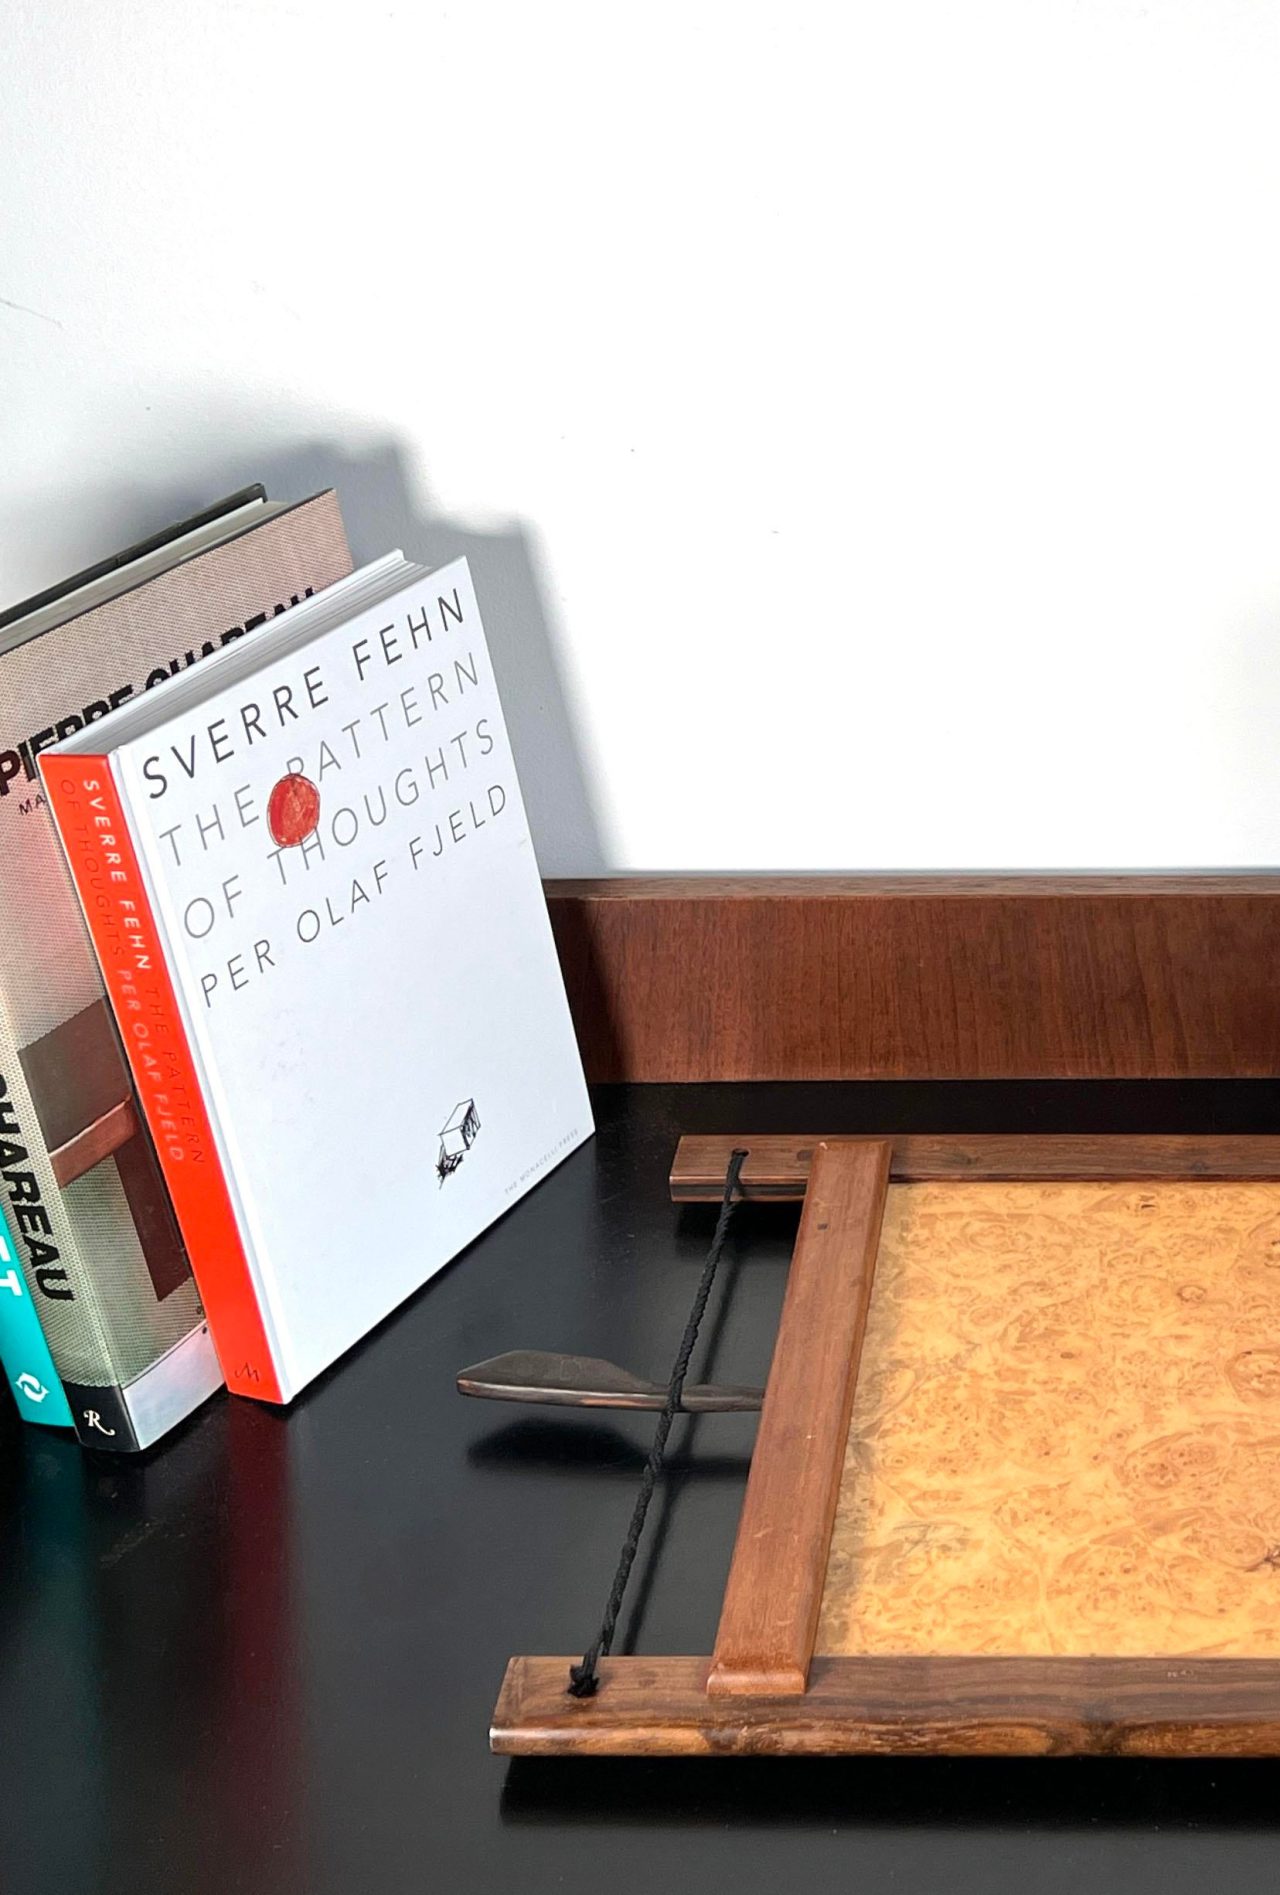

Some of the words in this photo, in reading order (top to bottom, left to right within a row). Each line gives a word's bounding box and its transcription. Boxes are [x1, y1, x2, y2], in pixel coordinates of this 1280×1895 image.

[142, 666, 331, 799] SVERRE
[351, 588, 468, 681] FEHN
[159, 785, 260, 867] THE
[287, 654, 481, 784] PATTERN
[183, 874, 244, 941] OF
[266, 720, 495, 888] THOUGHTS
[200, 941, 277, 1008] PER
[296, 861, 390, 943] OLAF
[409, 784, 508, 871] FJELD
[61, 779, 81, 810] OF
[74, 825, 125, 956] THOUGHTS
[117, 970, 142, 1011] PER
[132, 1022, 162, 1082] OLAF
[152, 1093, 184, 1161] FJELD
[83, 779, 128, 883] SVERRE
[119, 900, 152, 970] FEHN
[145, 987, 169, 1034] THE
[162, 1051, 205, 1163] PATTERN
[0, 1074, 75, 1301] HAREAU
